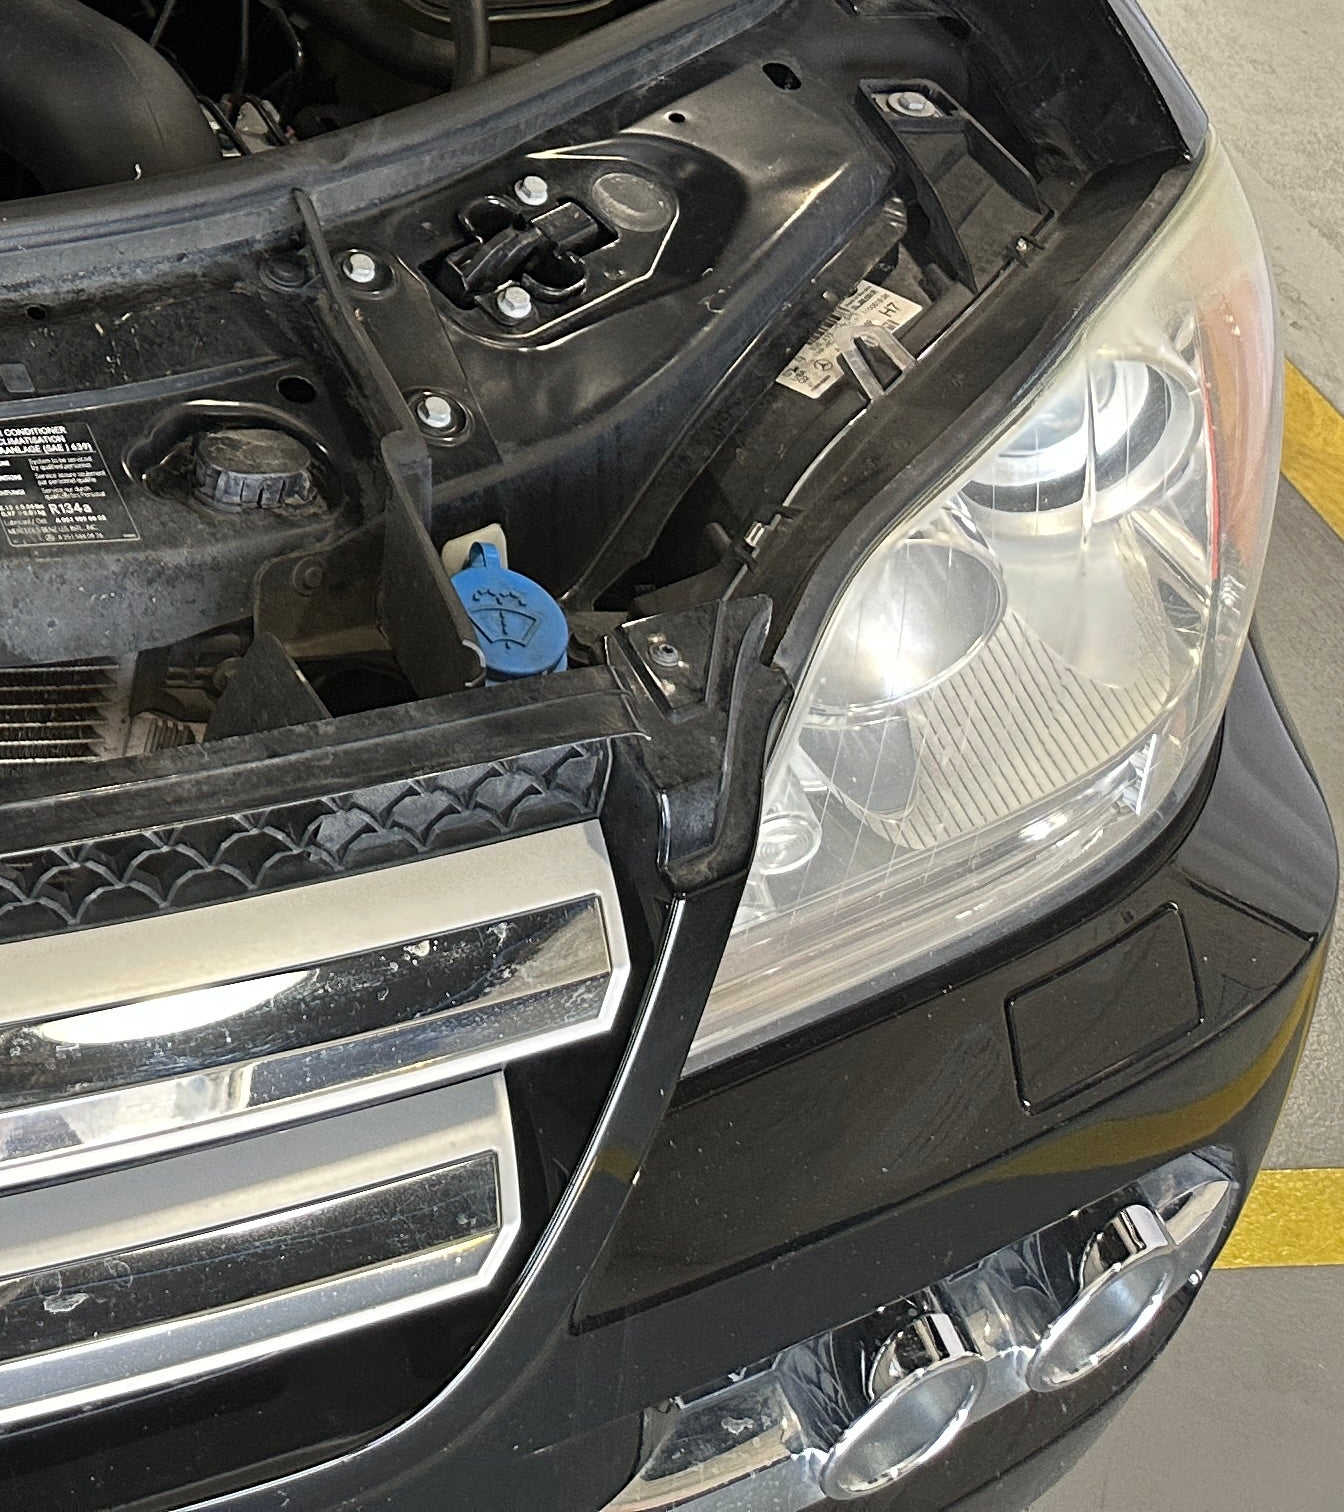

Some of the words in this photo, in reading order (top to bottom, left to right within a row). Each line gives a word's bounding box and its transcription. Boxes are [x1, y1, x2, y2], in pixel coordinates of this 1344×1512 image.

[878, 301, 900, 317] H7
[4, 426, 68, 436] CONDITIONER
[48, 502, 93, 516] R134a
